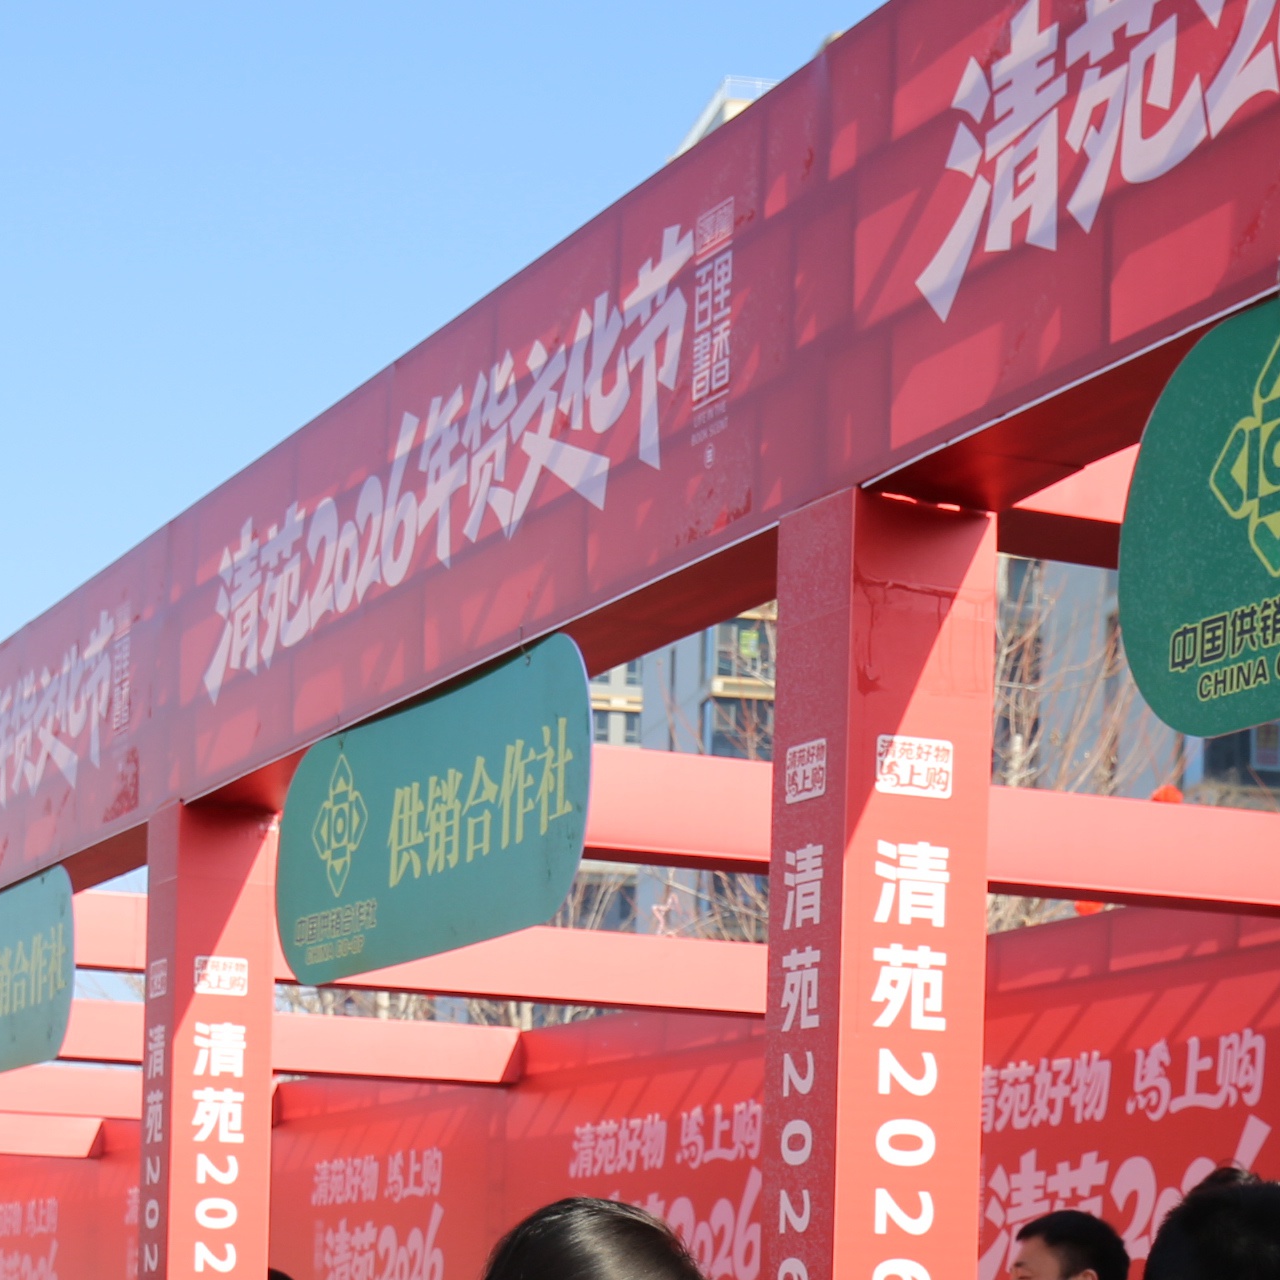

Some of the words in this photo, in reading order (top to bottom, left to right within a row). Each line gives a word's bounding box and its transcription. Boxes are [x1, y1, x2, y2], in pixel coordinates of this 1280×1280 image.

[204, 223, 693, 706] 清苑2026年货文化节
[1197, 656, 1269, 702] CHINA
[878, 739, 950, 764] 清苑好物
[387, 717, 574, 888] 供销合作社
[569, 1113, 667, 1178] 清苑好物
[311, 1154, 379, 1206] 清苑好物
